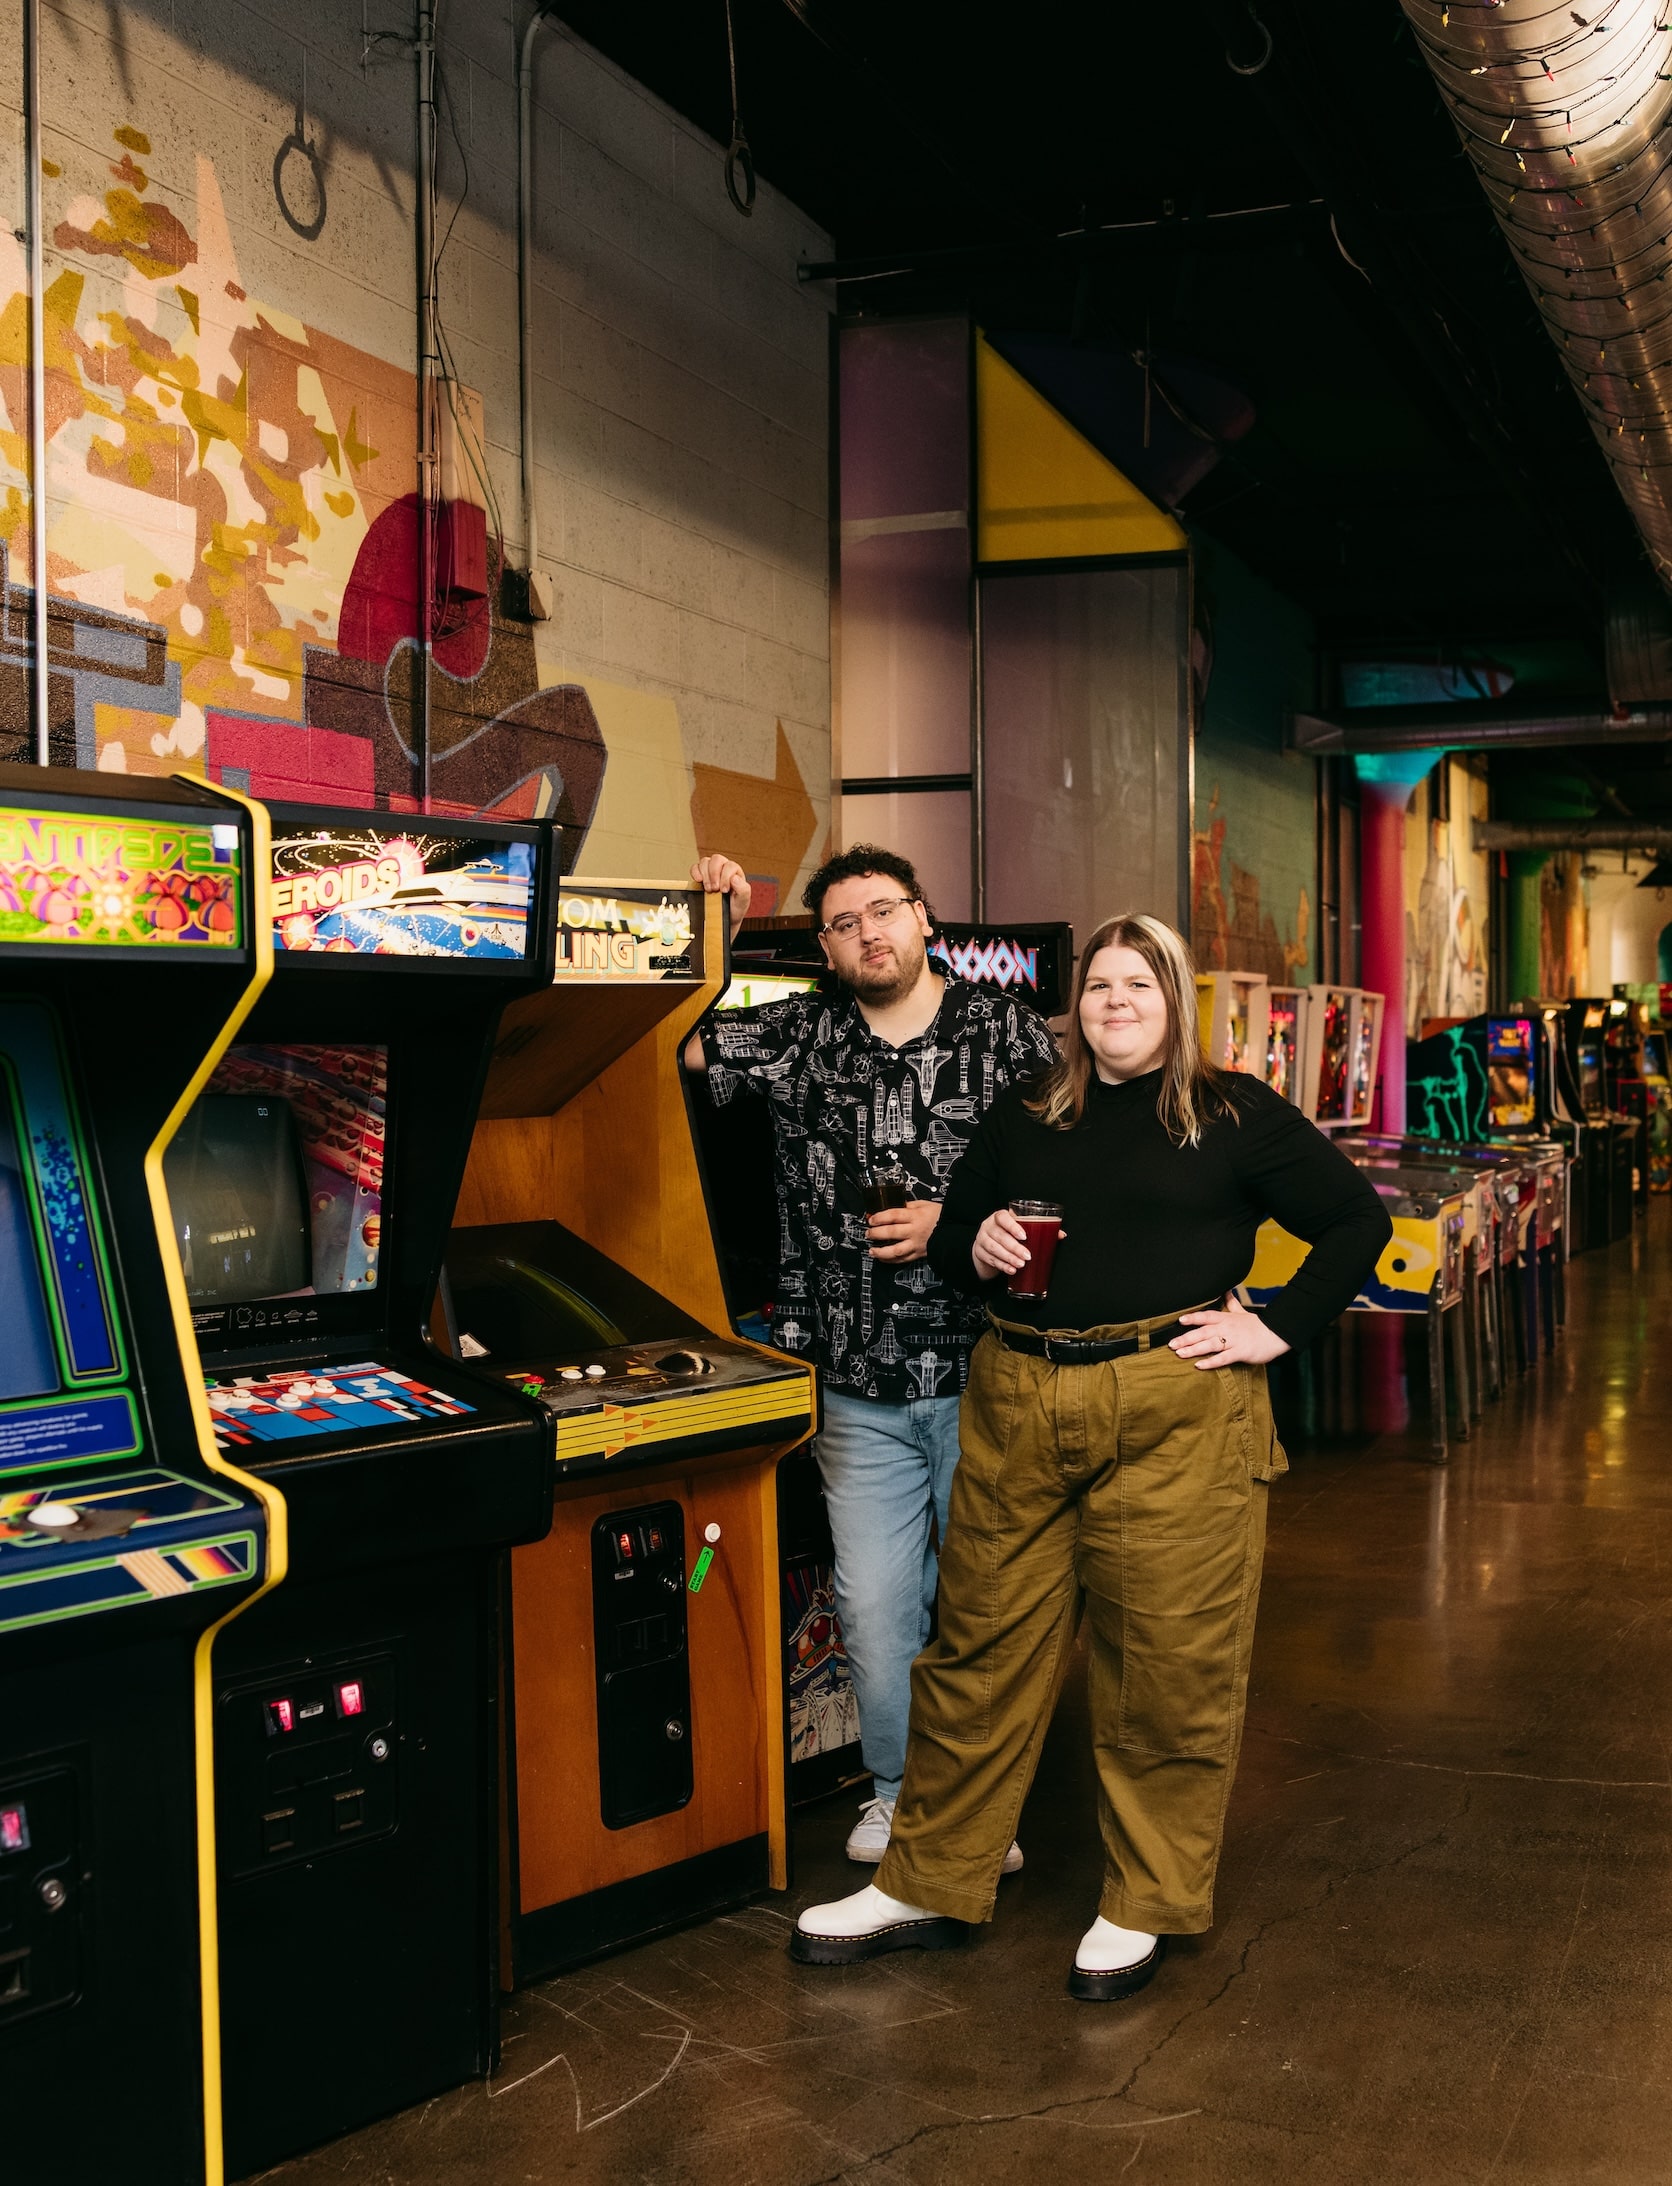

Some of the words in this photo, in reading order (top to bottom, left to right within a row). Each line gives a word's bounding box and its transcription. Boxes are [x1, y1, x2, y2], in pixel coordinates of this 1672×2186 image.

[271, 859, 399, 918] EROIDS
[557, 897, 621, 928] OM
[555, 931, 635, 969] LING
[927, 936, 1037, 992] XXON
